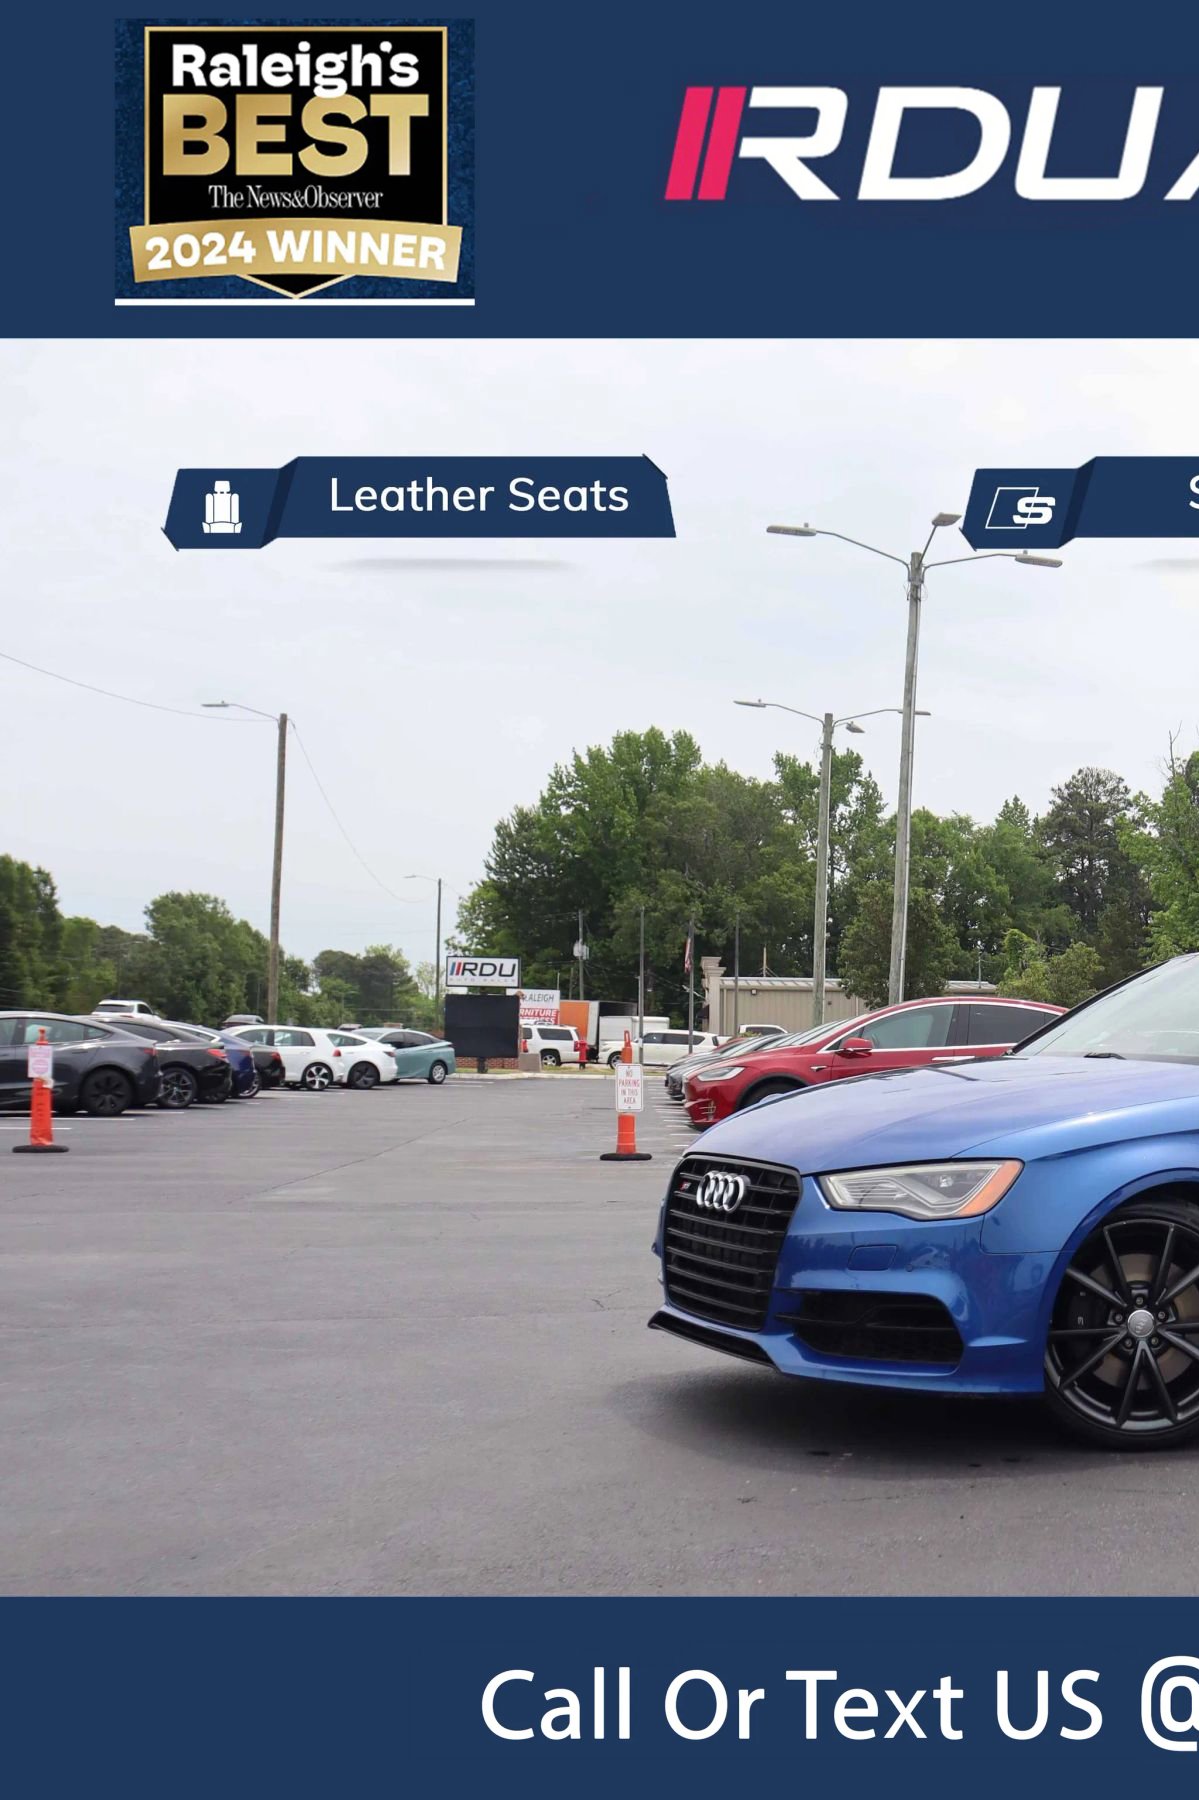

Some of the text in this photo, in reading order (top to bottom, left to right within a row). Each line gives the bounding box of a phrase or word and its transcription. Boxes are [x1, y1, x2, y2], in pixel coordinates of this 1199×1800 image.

[461, 962, 517, 977] RDU
[520, 1009, 557, 1017] RNITURE
[618, 1079, 640, 1087] PARKING
